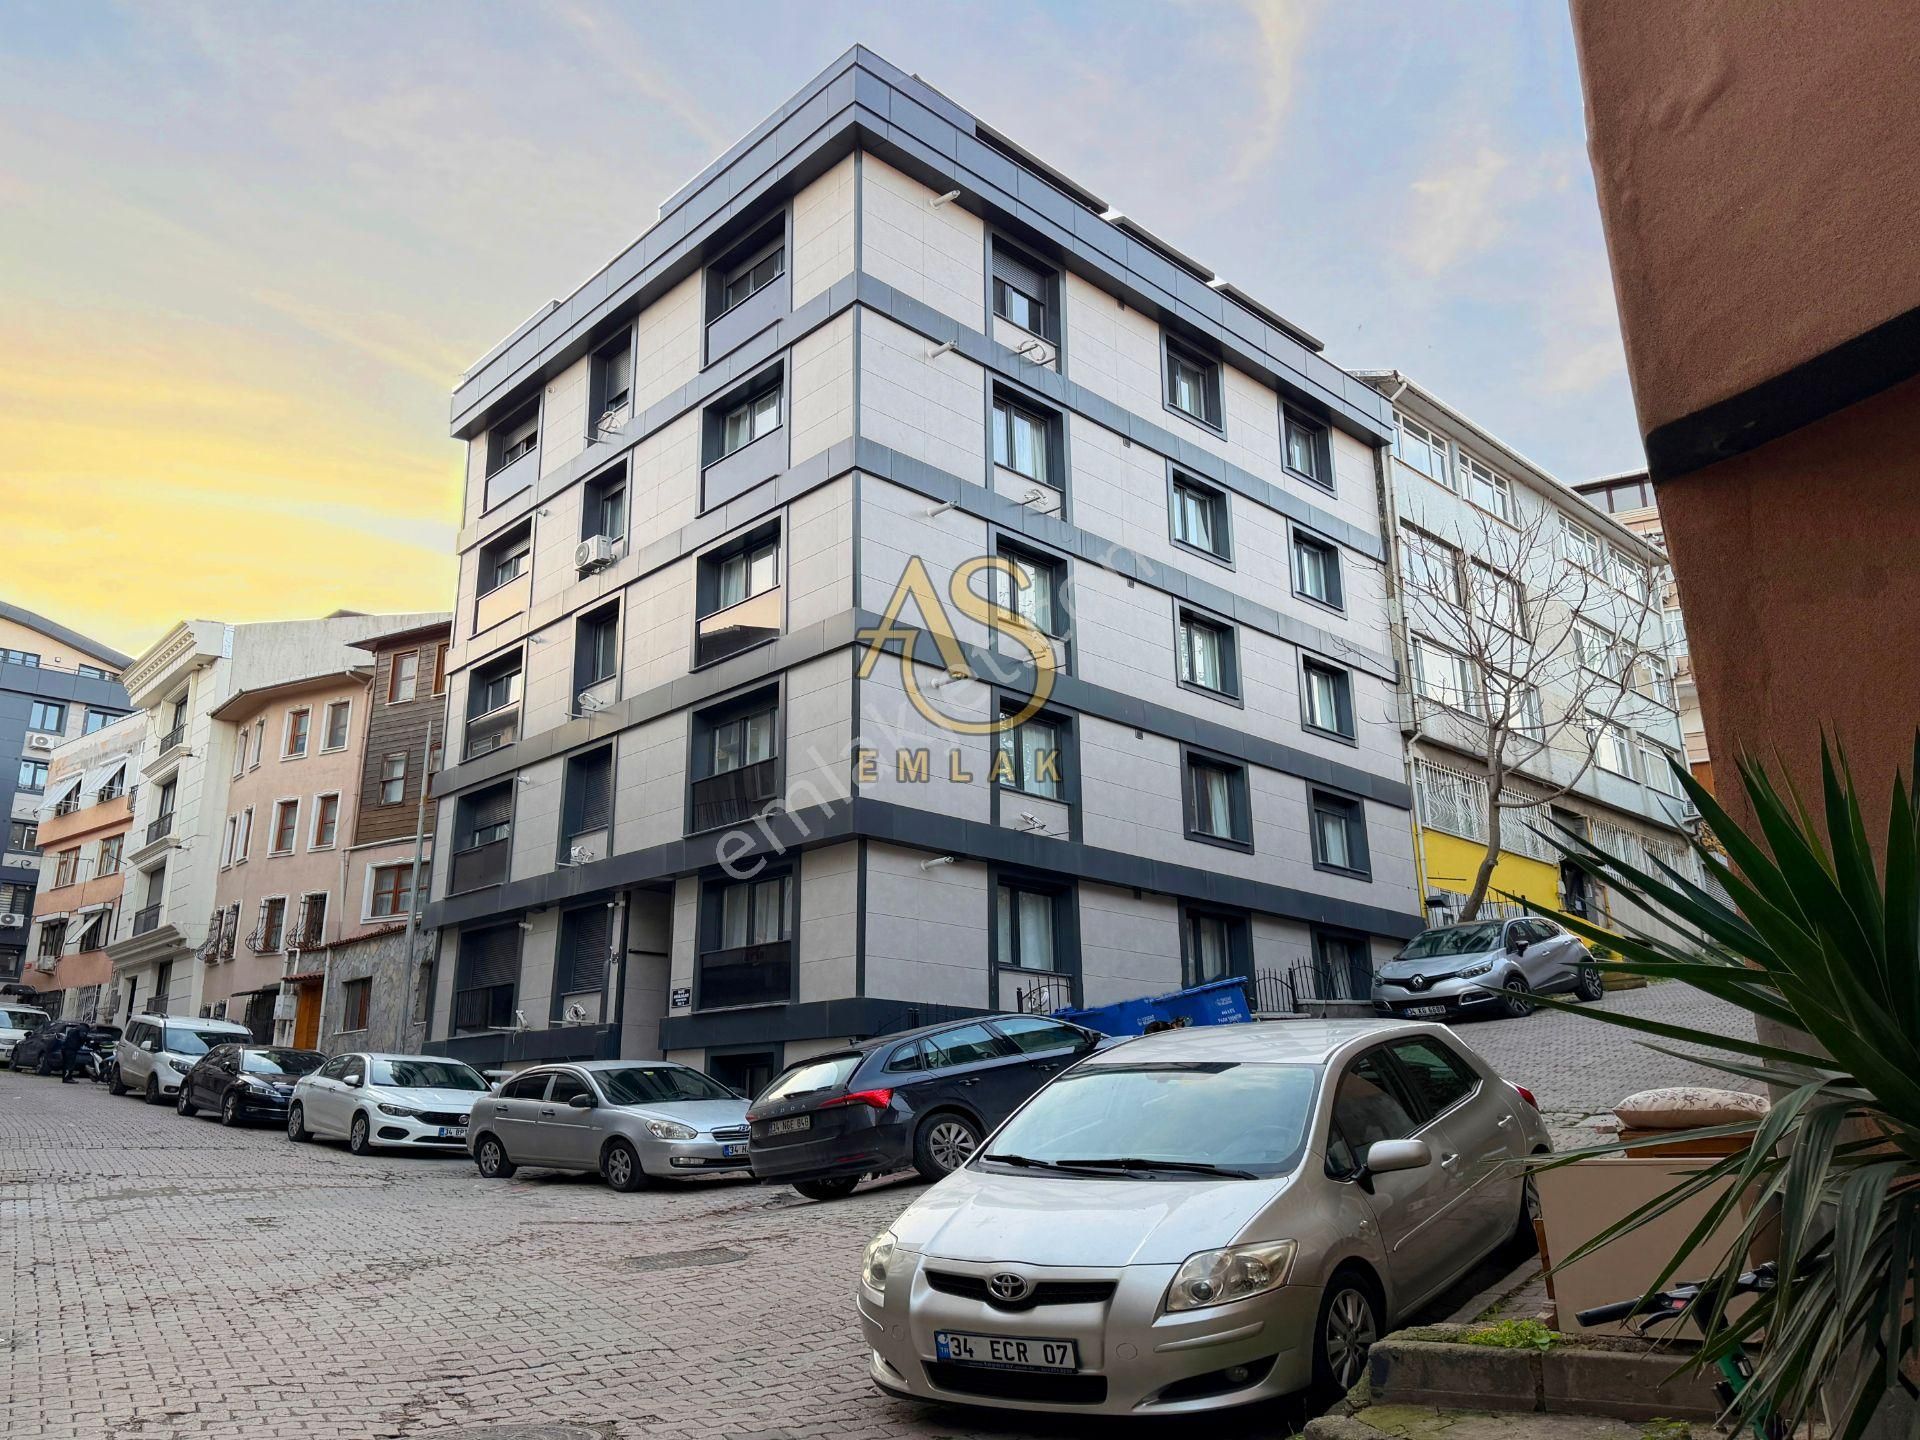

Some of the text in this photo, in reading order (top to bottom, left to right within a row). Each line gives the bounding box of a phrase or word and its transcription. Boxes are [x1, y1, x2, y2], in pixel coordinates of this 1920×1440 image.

[950, 1336, 975, 1359] 34
[989, 1340, 1030, 1363] ECR
[1042, 1343, 1069, 1366] 07
